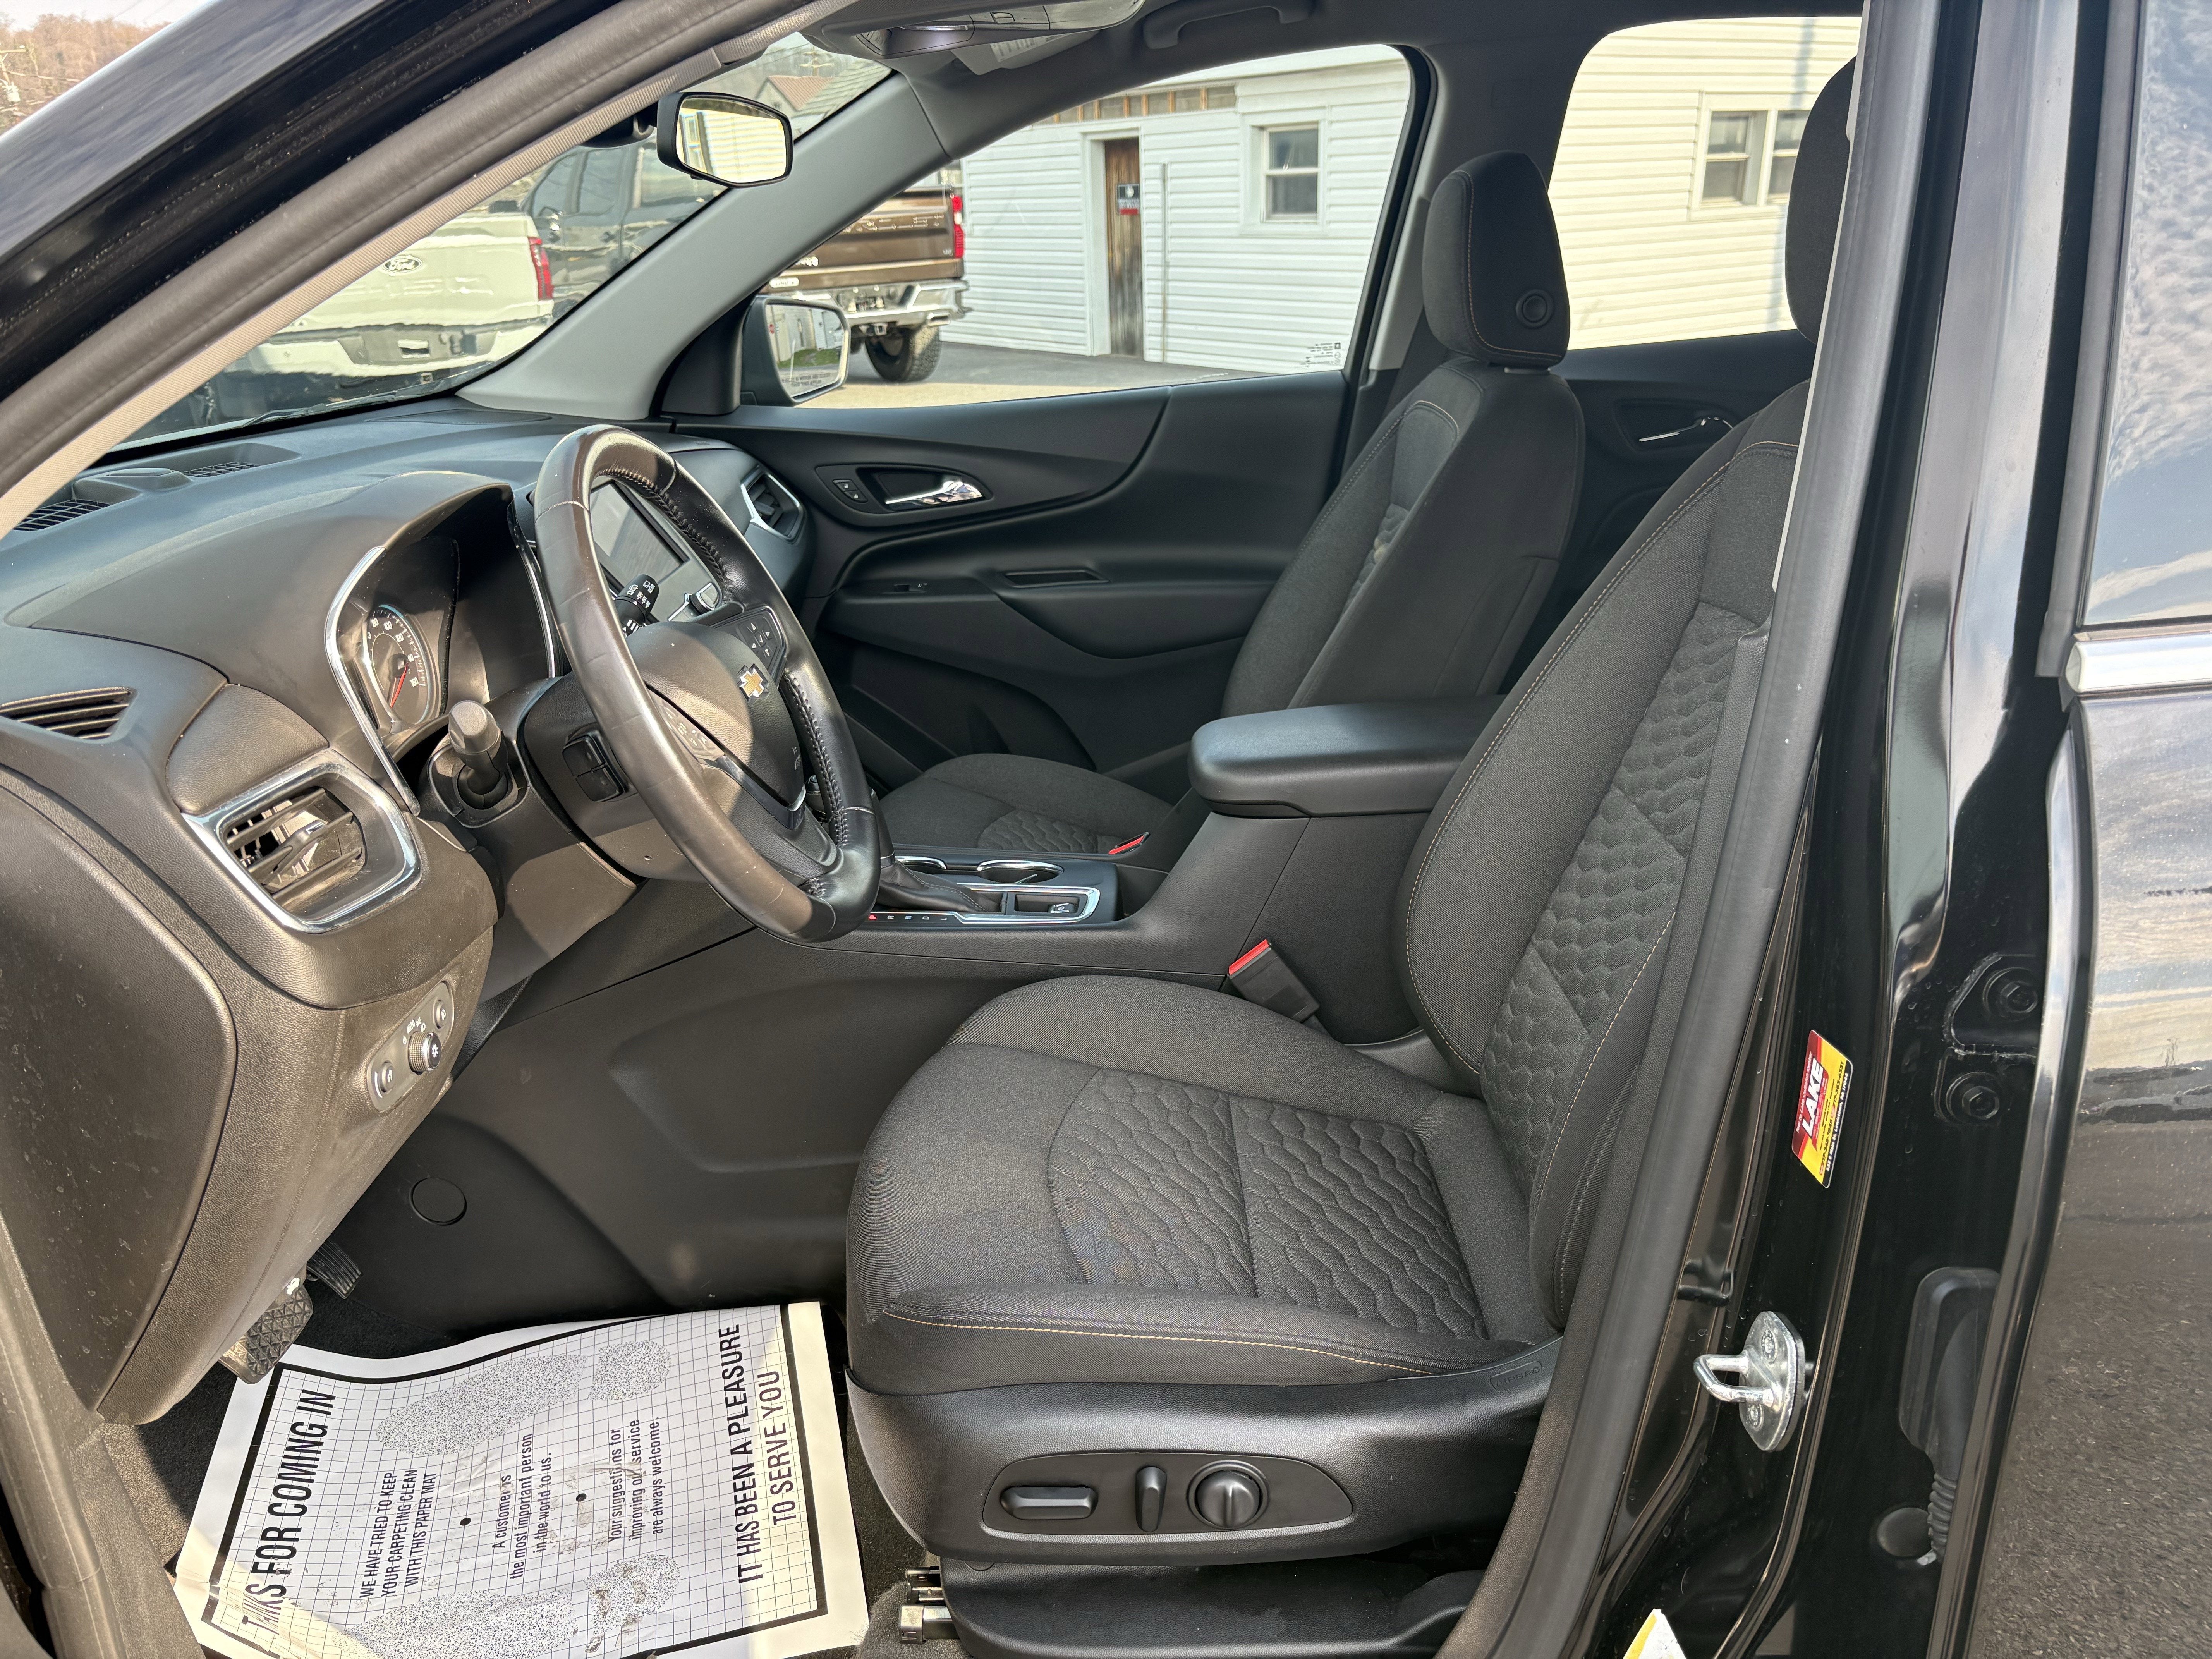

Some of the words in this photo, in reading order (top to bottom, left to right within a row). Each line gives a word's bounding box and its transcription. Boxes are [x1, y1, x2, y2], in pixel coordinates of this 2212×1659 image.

[383, 621, 393, 631] 100
[407, 1020, 415, 1034] AUTO
[1802, 1058, 1824, 1137] LAKE
[718, 1324, 750, 1436] PLEASURE
[757, 1370, 783, 1419] YOU
[297, 1389, 336, 1415] IN
[608, 1429, 621, 1445] for
[627, 1419, 642, 1463] service
[649, 1417, 662, 1476] welcome.
[730, 1439, 753, 1455] A
[521, 1433, 534, 1472] person
[541, 1452, 551, 1470] us.
[764, 1422, 793, 1494] SERVE
[267, 1421, 328, 1516] COMING
[421, 1473, 436, 1494] MAT
[539, 1475, 551, 1487] to
[380, 1472, 397, 1496] KEEP
[399, 1469, 418, 1501] CLEAN
[650, 1478, 665, 1516] always
[732, 1462, 758, 1516] BEEN
[376, 1499, 392, 1513] TO
[415, 1496, 433, 1528] PAPER
[495, 1491, 511, 1537] customer
[514, 1475, 532, 1529] important
[537, 1489, 551, 1520] world
[628, 1488, 646, 1540] improving
[772, 1500, 797, 1525] TO
[370, 1516, 388, 1546] TRIED
[387, 1504, 412, 1562] CARPETING
[534, 1522, 548, 1539] the
[608, 1520, 623, 1542] Your
[652, 1519, 663, 1534] are
[735, 1520, 761, 1556] HAS
[251, 1527, 302, 1574] FOR
[410, 1530, 426, 1555] THIS
[512, 1529, 527, 1558] most
[533, 1541, 547, 1553] in
[364, 1549, 383, 1576] HAVE
[404, 1557, 422, 1587] WITH
[509, 1561, 524, 1578] the
[737, 1563, 763, 1583] IT
[359, 1580, 377, 1597] WE
[381, 1565, 400, 1596] YOUR
